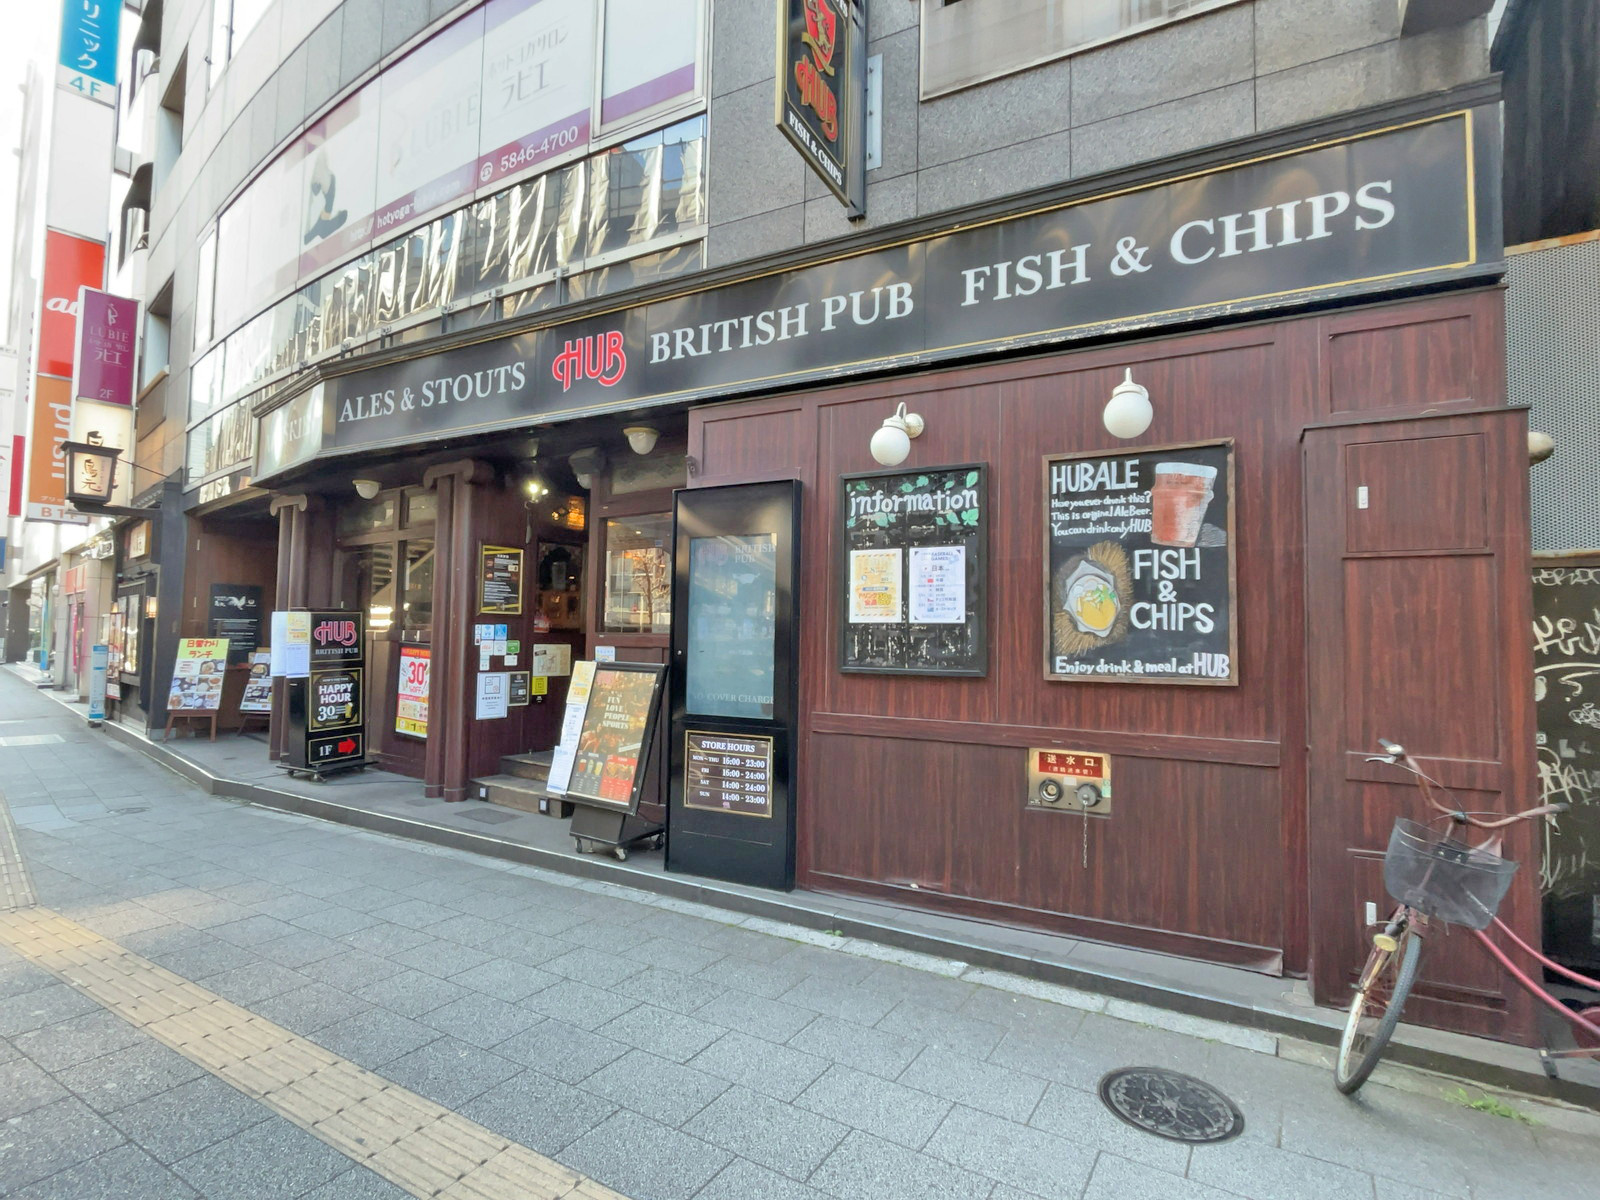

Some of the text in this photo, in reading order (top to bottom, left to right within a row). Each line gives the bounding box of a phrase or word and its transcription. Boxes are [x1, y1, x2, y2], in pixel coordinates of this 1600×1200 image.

[69, 76, 101, 97] 4F
[500, 58, 551, 111] ラビエ
[499, 125, 579, 173] 5846-4700
[788, 110, 842, 186] FISH & CHIPS
[961, 178, 1397, 307] FISH & CHIPS
[649, 280, 915, 365] BRITISH PUB
[552, 329, 628, 394] HUB
[99, 388, 114, 399] 2F
[338, 388, 396, 424] ALES
[400, 385, 415, 412] &
[420, 360, 526, 408] STOUTS
[850, 489, 979, 517] information
[1051, 512, 1070, 520] This
[1071, 511, 1080, 520] is
[1129, 518, 1153, 532] HUB
[1133, 548, 1201, 581] FISH
[1157, 580, 1178, 603] &
[1129, 601, 1215, 634] CHIPS
[313, 620, 358, 647] HUB
[315, 648, 344, 656] BRITISH
[1055, 652, 1230, 678] Enjoy drink & meal at HUB
[408, 661, 425, 686] 30
[318, 682, 354, 695] HAPPY
[320, 692, 352, 704] HOUR
[317, 705, 336, 721] 30
[604, 712, 630, 721] PEOPLE
[602, 720, 629, 730] SPORTS
[319, 745, 333, 757] 1F
[701, 740, 755, 752] STORE HOURS
[745, 759, 765, 768] 23:00
[1047, 753, 1094, 767] 送水口
[745, 771, 765, 780] 24:00
[722, 781, 739, 789] 14:00
[745, 783, 765, 792] 24:00
[721, 793, 739, 801] 14:00
[745, 795, 765, 804] 23:00
